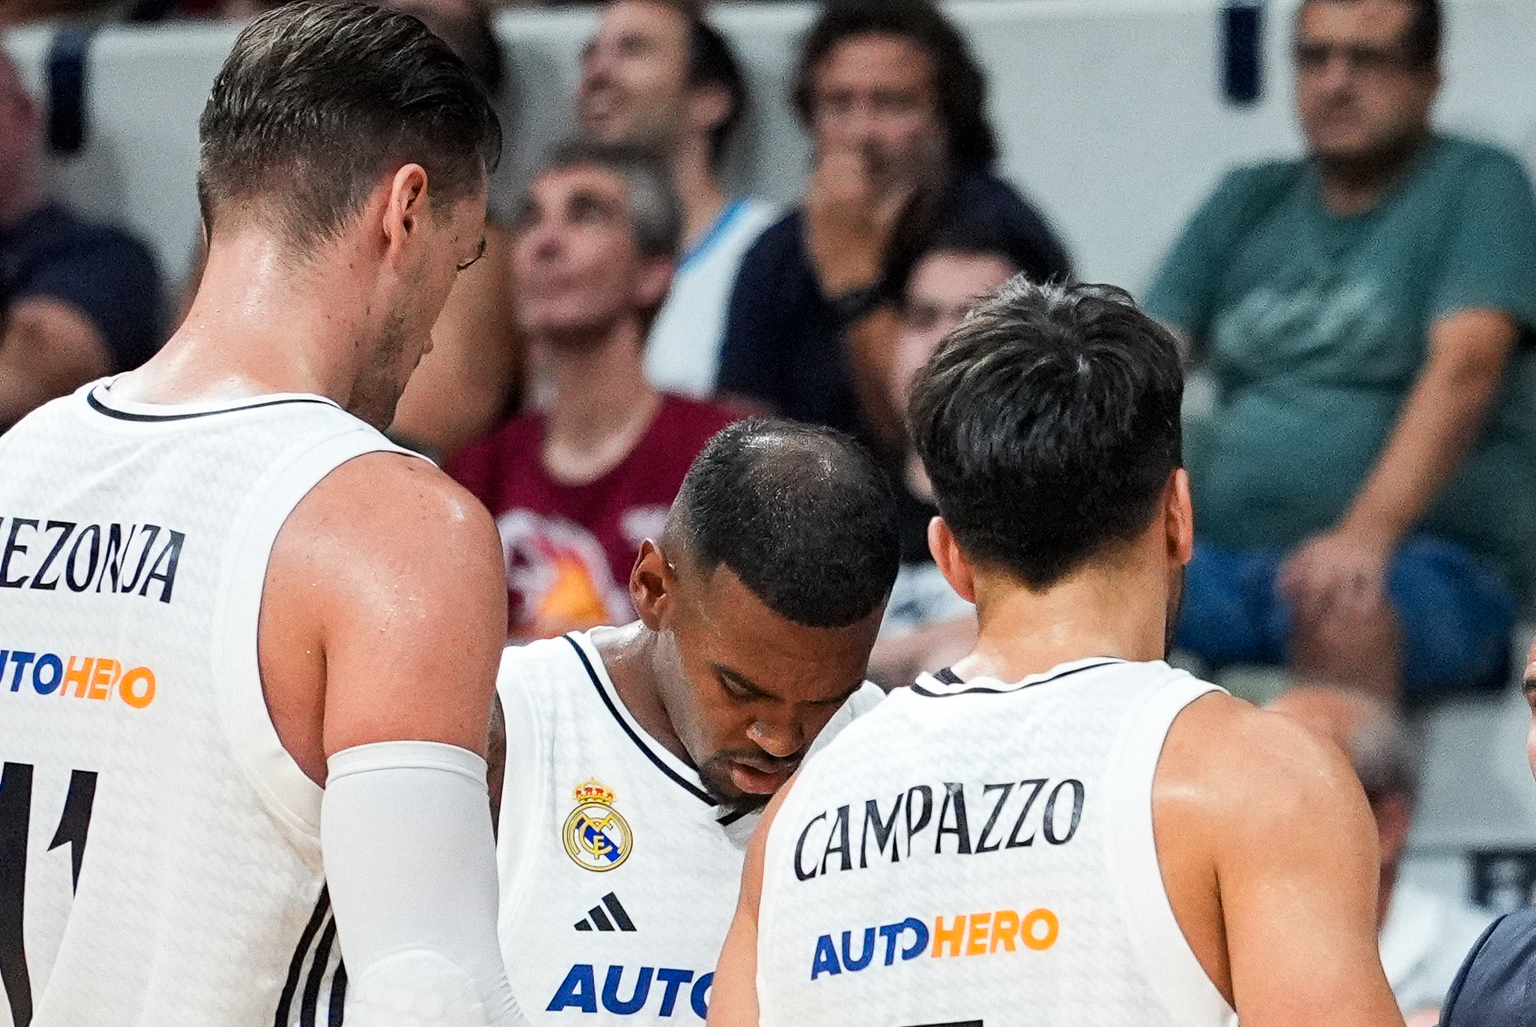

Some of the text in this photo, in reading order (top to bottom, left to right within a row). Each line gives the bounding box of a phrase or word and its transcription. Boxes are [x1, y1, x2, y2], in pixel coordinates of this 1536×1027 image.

[0, 517, 186, 604] EZONJA
[794, 778, 1085, 881] CAMPAZZO
[811, 908, 1059, 981] AUTOHERO
